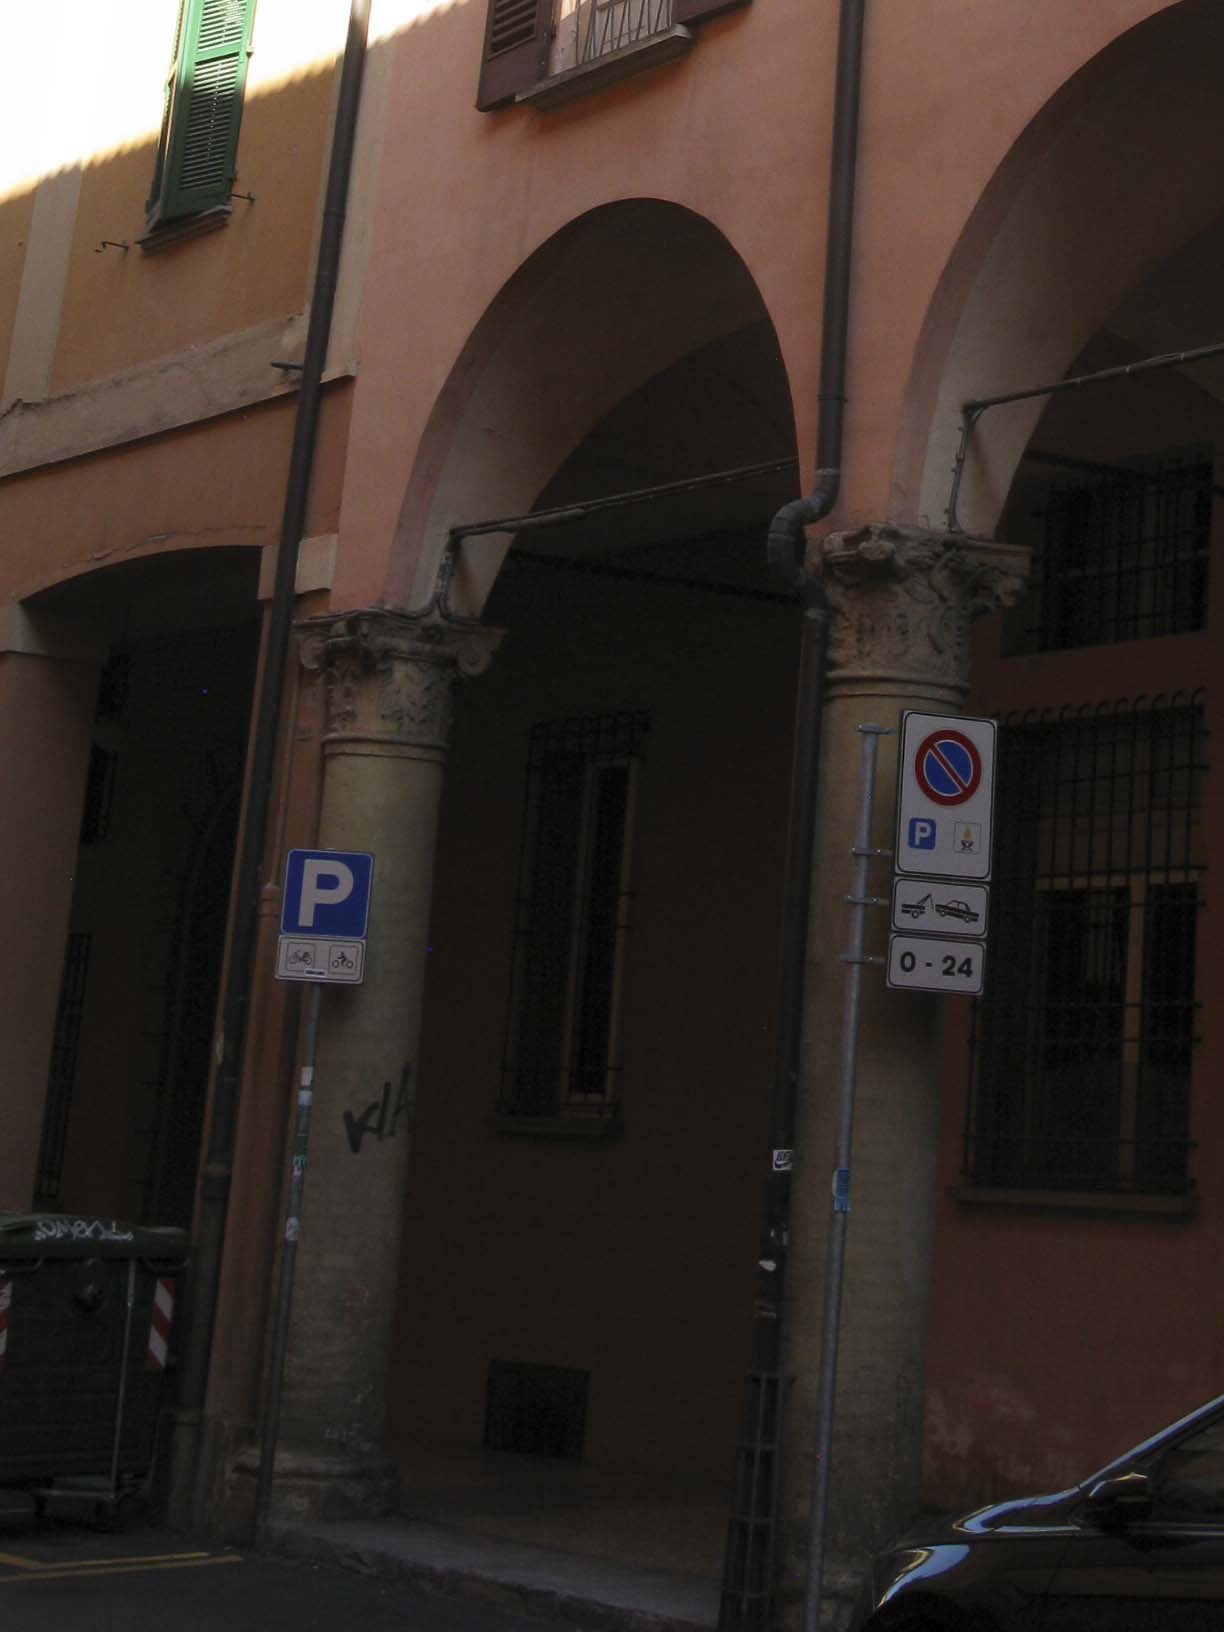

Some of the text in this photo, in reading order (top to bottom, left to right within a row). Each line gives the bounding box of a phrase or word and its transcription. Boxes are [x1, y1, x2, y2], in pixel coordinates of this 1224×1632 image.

[913, 821, 932, 847] P
[297, 858, 354, 928] P
[900, 951, 916, 973] 0
[941, 955, 973, 978] 24
